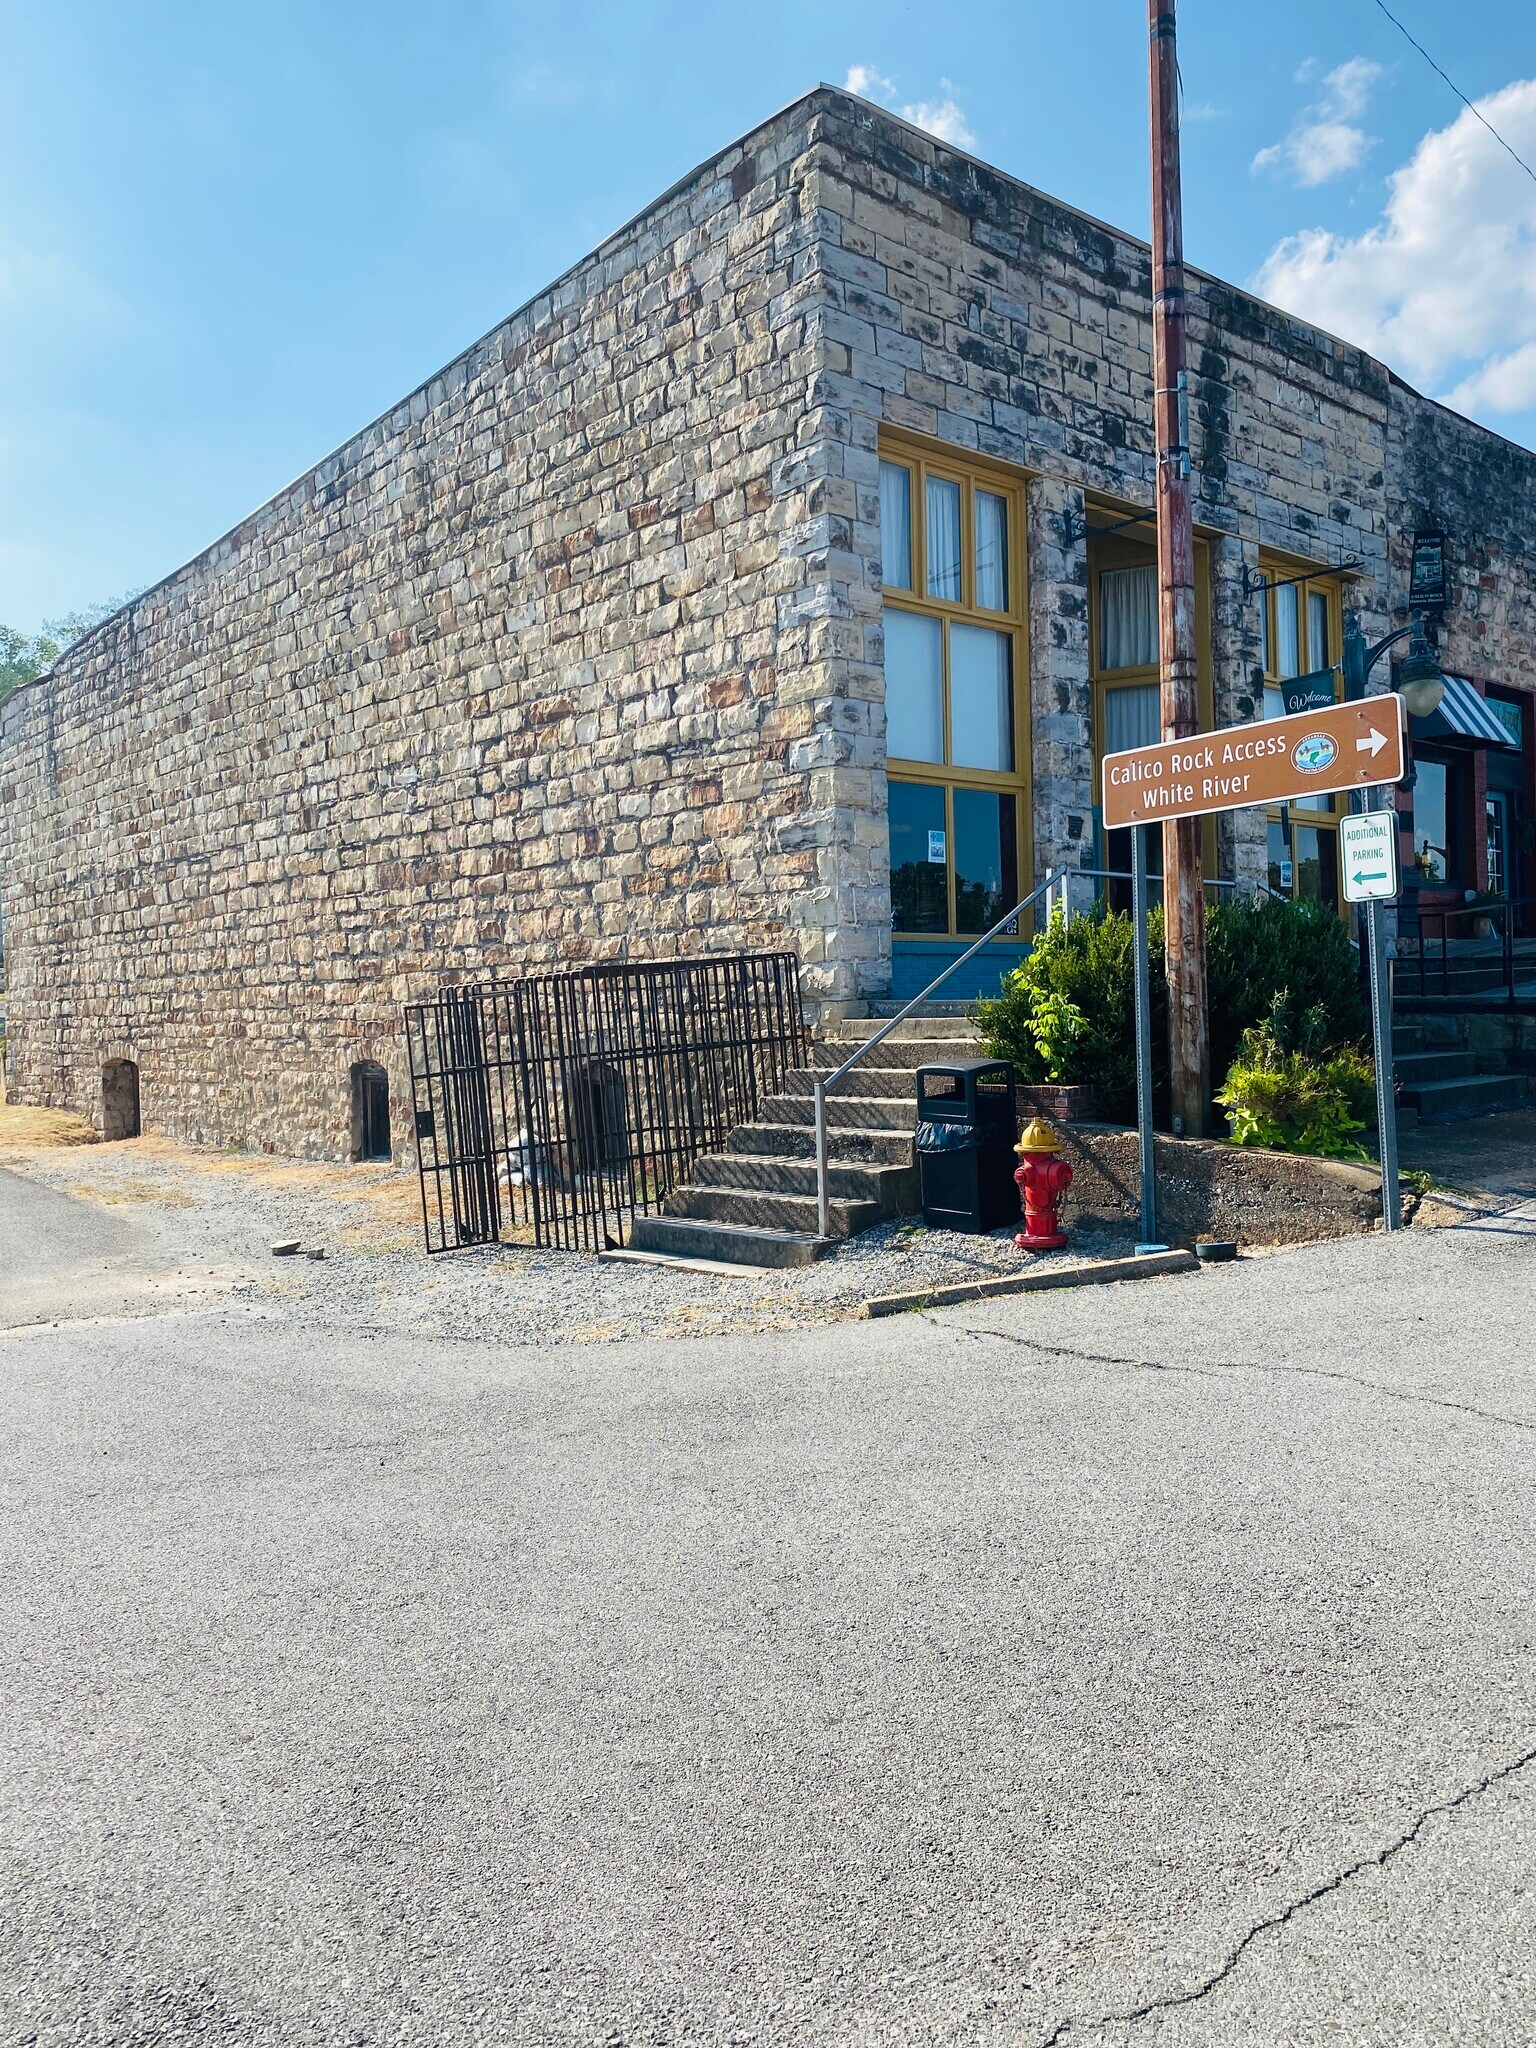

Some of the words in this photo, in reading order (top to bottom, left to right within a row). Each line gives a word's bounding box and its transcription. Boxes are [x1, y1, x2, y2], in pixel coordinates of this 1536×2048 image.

[1289, 690, 1332, 710] Welcome
[1110, 760, 1163, 786] Calico
[1171, 746, 1214, 774] Rock
[1222, 735, 1287, 764] Access
[1143, 784, 1194, 809] White
[1203, 773, 1251, 799] River
[1346, 826, 1388, 841] ADDITIONAL
[1352, 848, 1384, 861] PARKING
